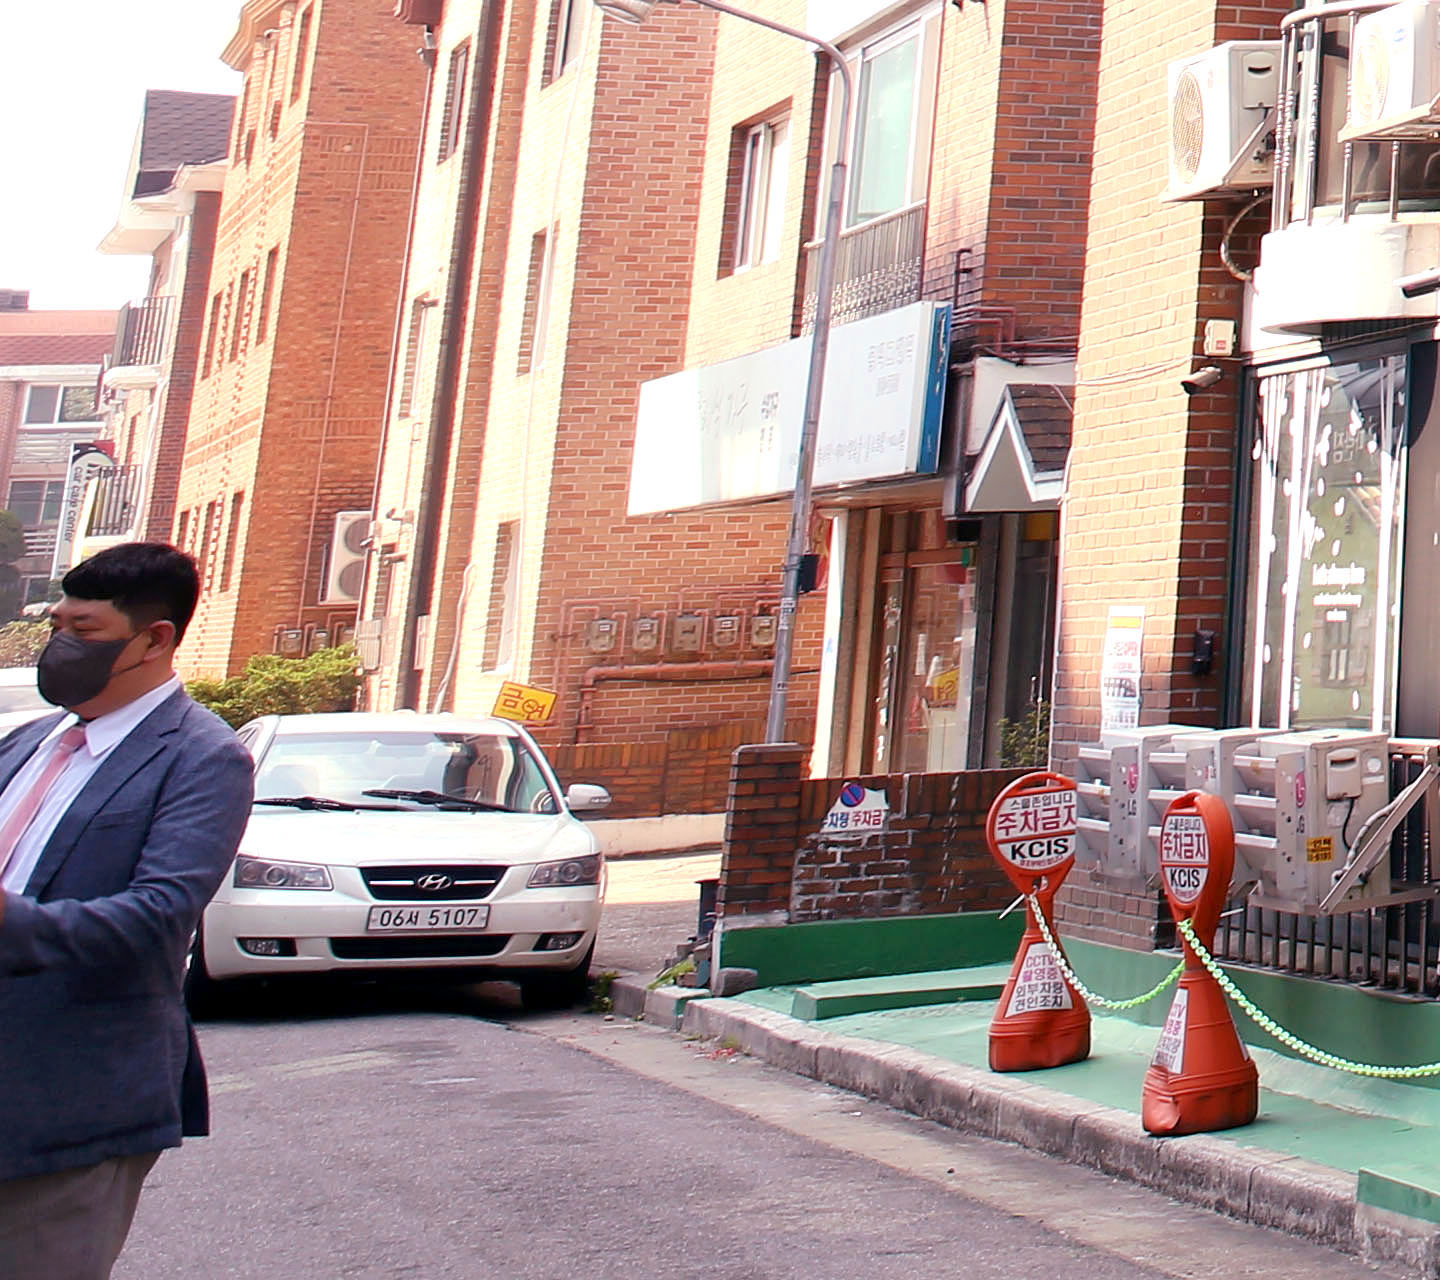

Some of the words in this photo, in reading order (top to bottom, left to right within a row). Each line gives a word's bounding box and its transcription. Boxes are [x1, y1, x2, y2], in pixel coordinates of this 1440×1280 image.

[502, 687, 547, 721] 금연
[1010, 792, 1073, 809] 스쿨존입니다
[823, 812, 849, 828] 차량
[852, 809, 888, 828] 주차금
[1010, 837, 1070, 861] KCIS
[1164, 832, 1206, 860] 주차금지
[1170, 867, 1201, 889] KCIS
[380, 910, 420, 927] 06서
[428, 908, 480, 926] 5107
[1016, 983, 1064, 999] 외부차량
[1015, 995, 1064, 1012] 견인조치
